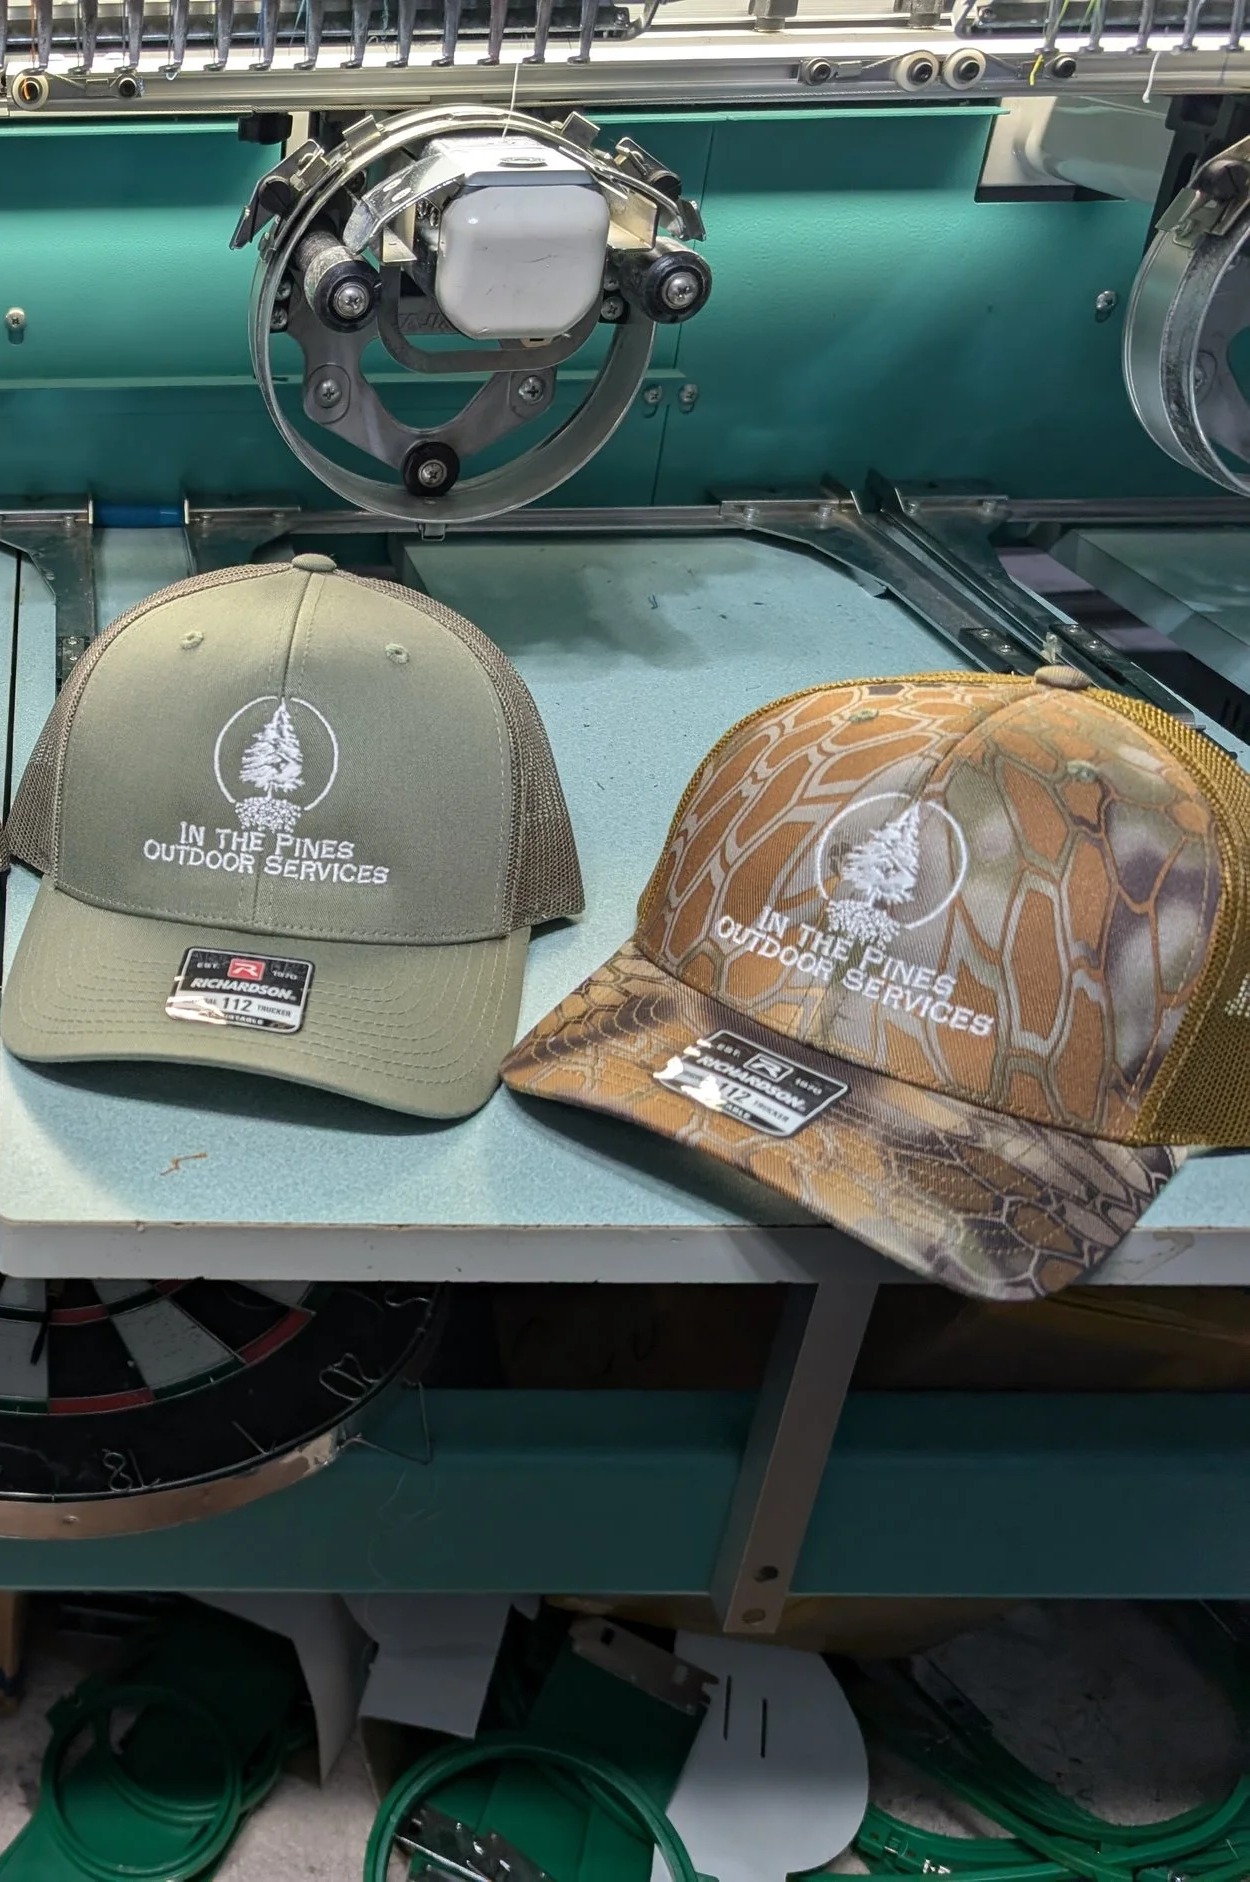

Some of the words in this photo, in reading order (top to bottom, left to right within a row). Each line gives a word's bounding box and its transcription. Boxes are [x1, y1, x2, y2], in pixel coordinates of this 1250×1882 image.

[179, 820, 205, 847] IN
[215, 828, 266, 853] THE
[275, 832, 355, 860] PINES
[143, 839, 255, 874] OUTDOOR
[263, 855, 390, 884] SERVICES
[758, 905, 791, 940] IN
[799, 923, 855, 961] THE
[859, 946, 958, 996] PINES
[716, 915, 836, 982] OUTDOOR
[842, 967, 995, 1037] SERVICES
[223, 996, 253, 1012] 112
[256, 1004, 292, 1018] TRUCKER
[753, 1099, 791, 1123] TRUCKER
